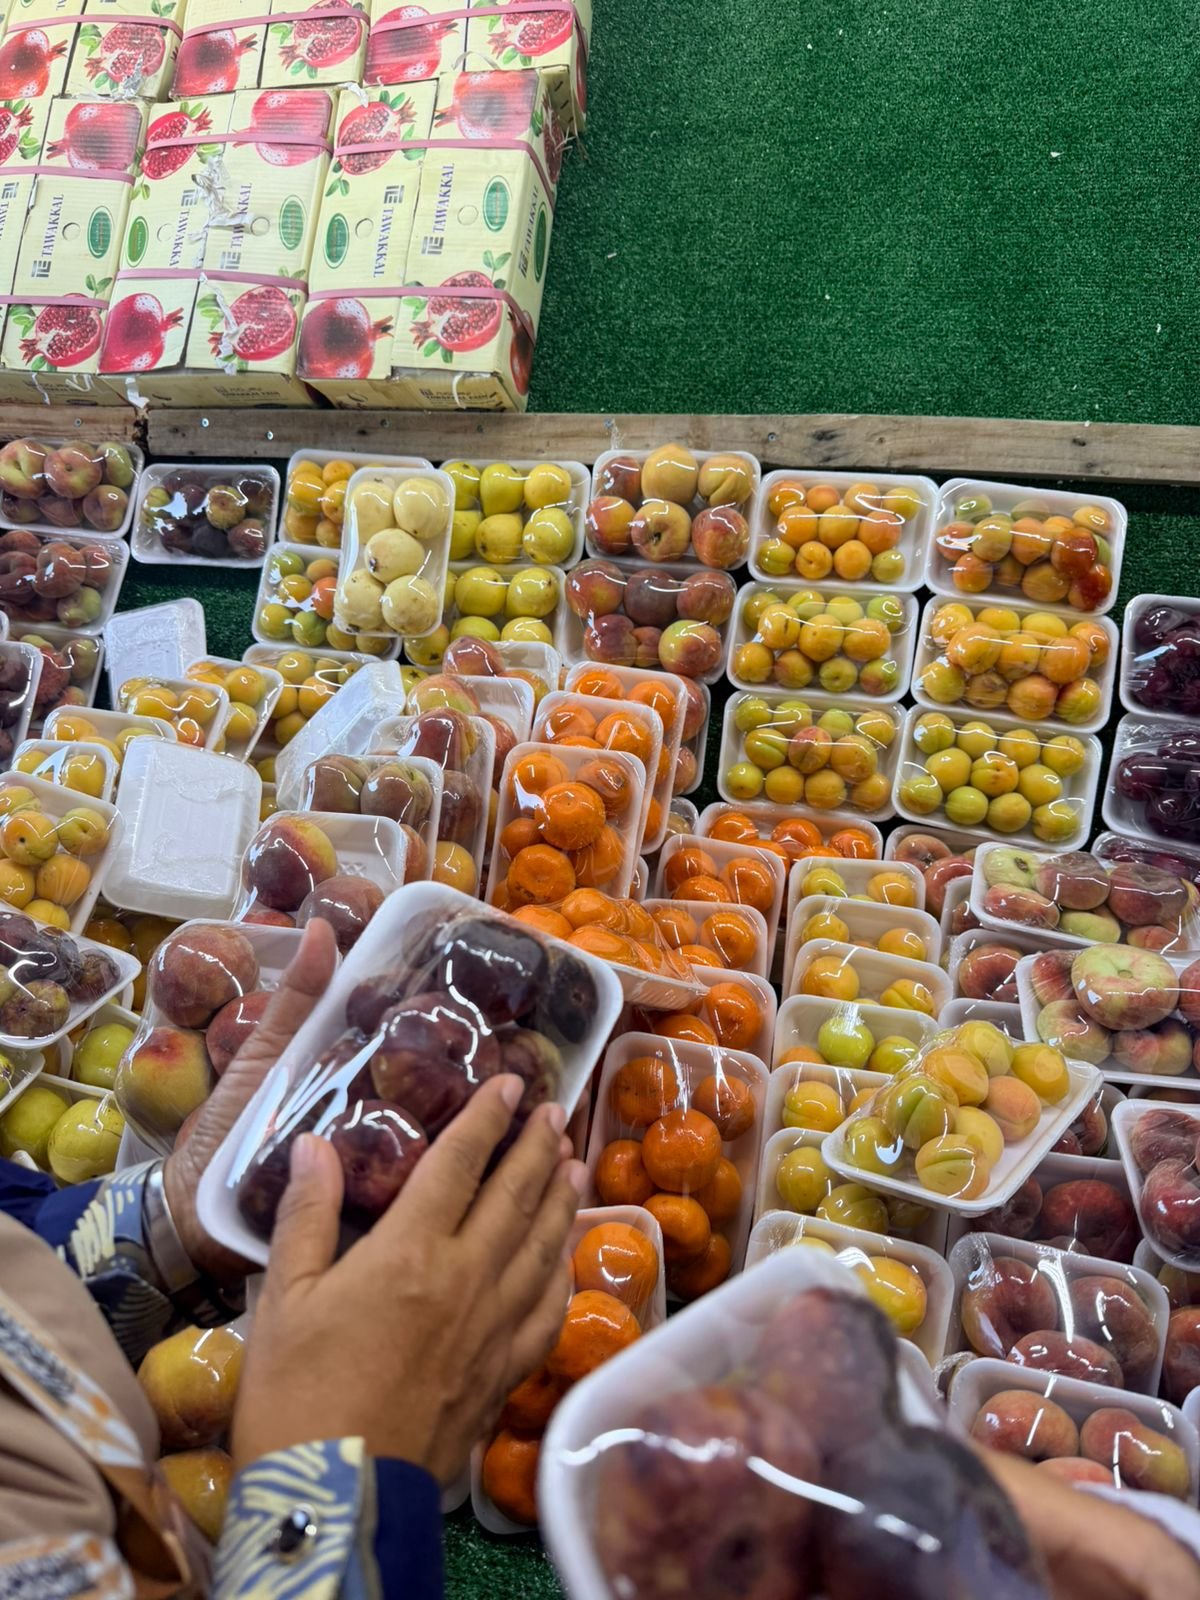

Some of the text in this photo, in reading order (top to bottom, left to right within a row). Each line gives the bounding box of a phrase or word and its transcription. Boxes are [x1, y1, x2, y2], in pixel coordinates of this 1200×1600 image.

[41, 193, 65, 258] TAWAKKAL
[230, 183, 253, 248] TAWKKAL
[433, 163, 456, 234] TAWAKKAL
[169, 208, 191, 268] TAWAKKA
[373, 207, 395, 279] TAWAKKAL
